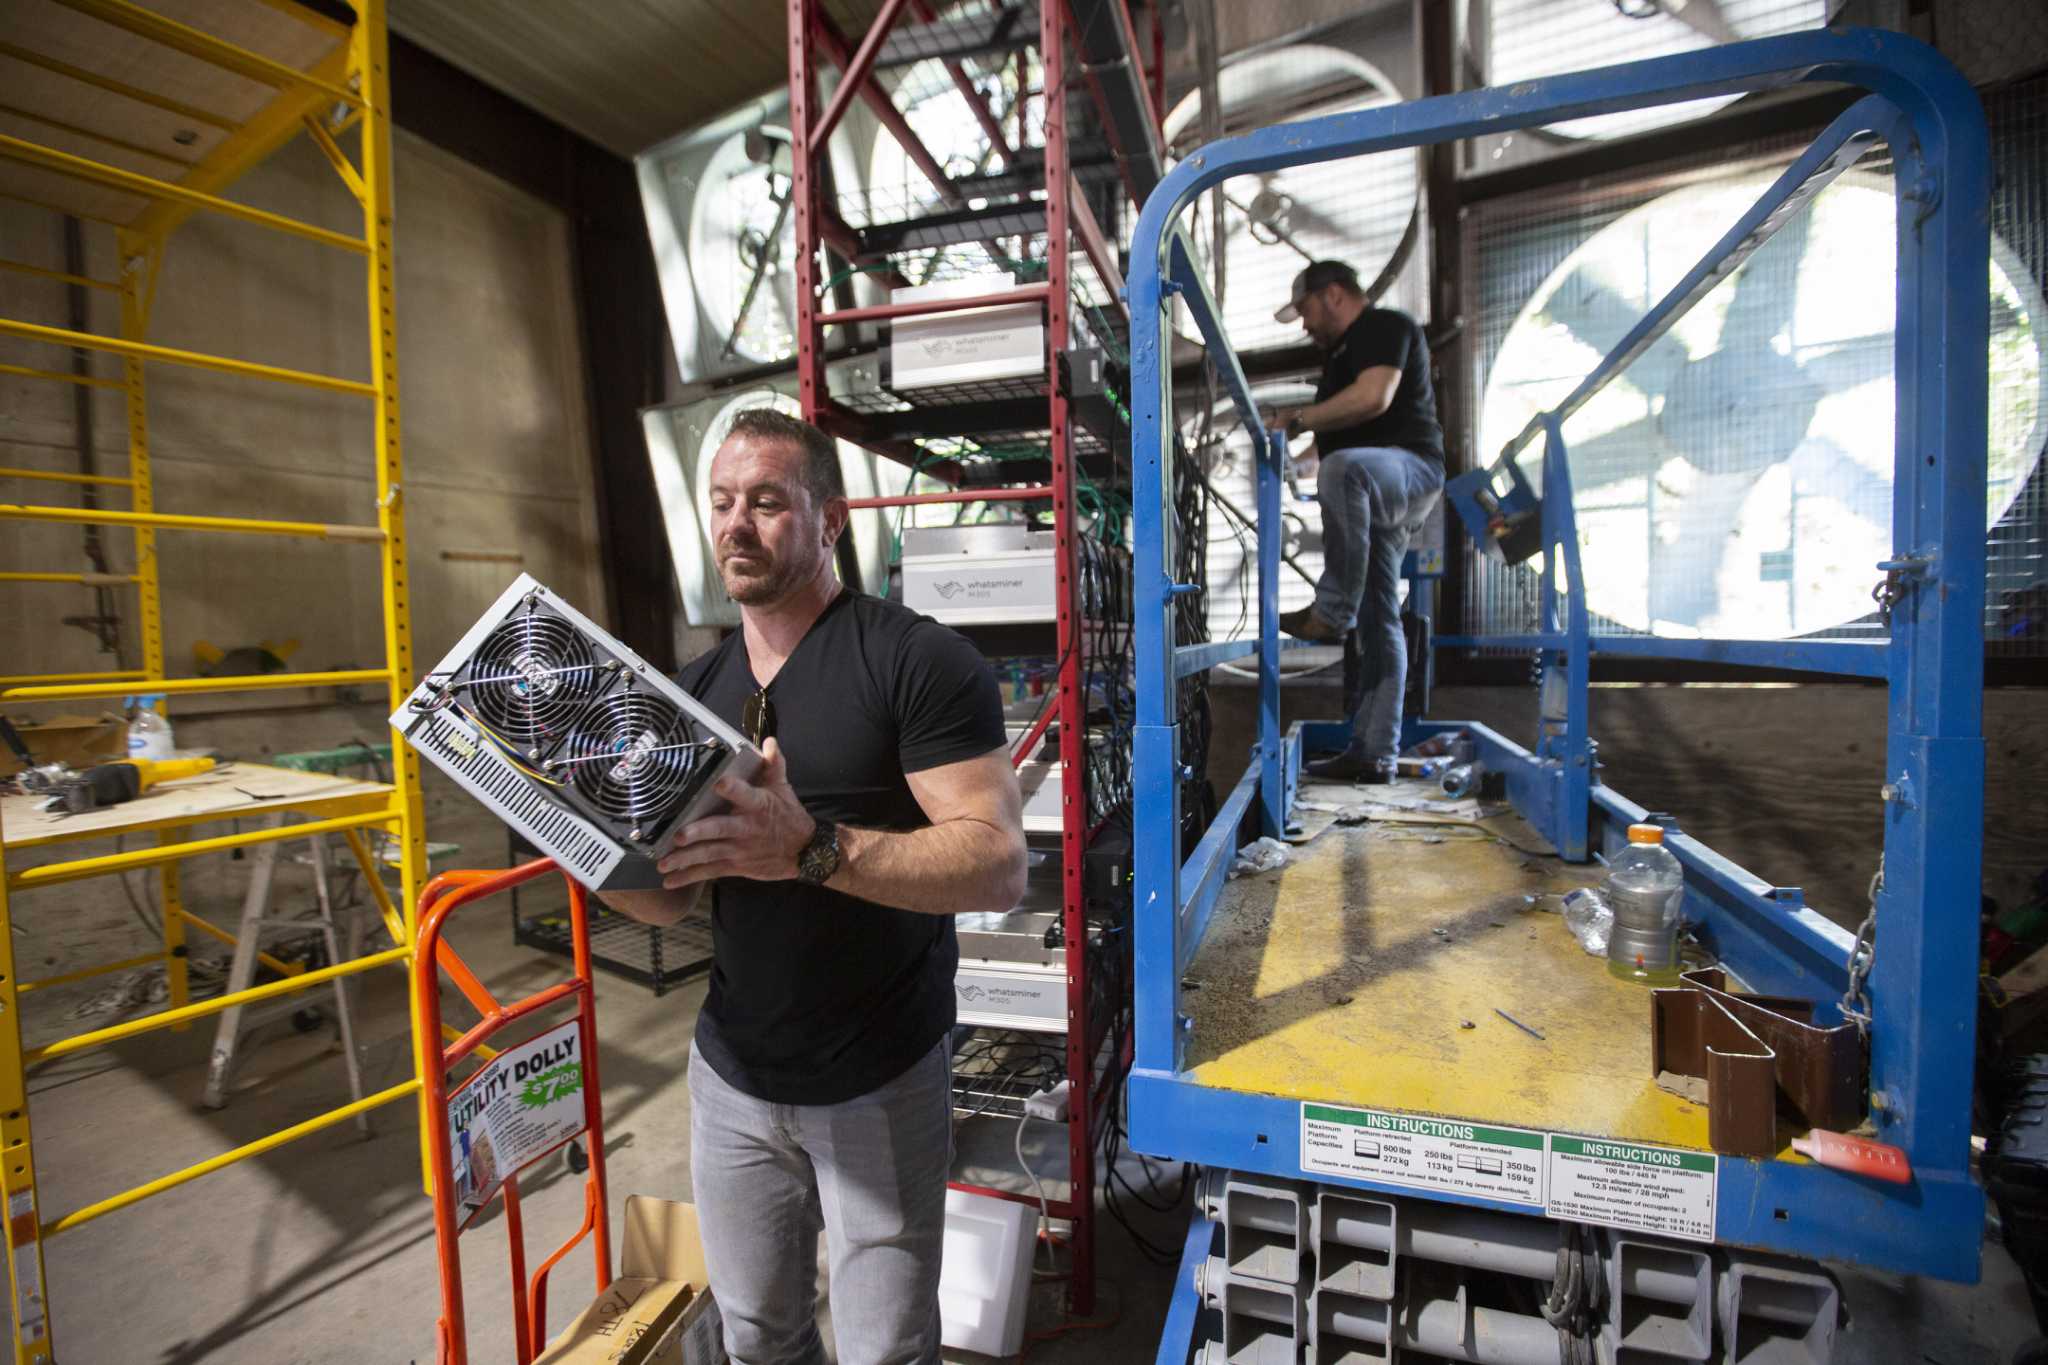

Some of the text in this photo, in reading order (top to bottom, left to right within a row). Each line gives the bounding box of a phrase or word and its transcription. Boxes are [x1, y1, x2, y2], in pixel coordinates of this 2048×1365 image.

[968, 578, 1023, 588] whatsminer
[988, 988, 1041, 998] whatsminer
[454, 1067, 510, 1132] UTILITY
[514, 1036, 575, 1082] DOLLY
[1308, 1123, 1341, 1132] Maximum
[1367, 1113, 1474, 1139] INSTRUCTIONS
[1308, 1131, 1337, 1140] Platform
[1354, 1128, 1411, 1142] Platform retracted
[1308, 1139, 1343, 1149] Capacities
[1450, 1141, 1512, 1155] Platform extended
[1399, 1146, 1411, 1155] lbs
[1424, 1150, 1453, 1161] 250 lbs
[1583, 1142, 1681, 1166] INSTRUCTIONS
[1384, 1155, 1409, 1166] 272 kg
[1561, 1154, 1592, 1163] Maximum
[1594, 1158, 1625, 1168] allowable
[1643, 1165, 1660, 1173] force
[1427, 1161, 1453, 1173] 113 kg
[1506, 1162, 1536, 1172] 350 lbs
[1523, 1174, 1534, 1185] kg
[1577, 1173, 1608, 1182] Maximum
[1611, 1179, 1641, 1188] allowable
[1574, 1192, 1605, 1200] Maximum
[1607, 1197, 1632, 1205] number
[1580, 1204, 1611, 1213] Maximum
[1580, 1211, 1611, 1220] Maximum
[1613, 1216, 1641, 1225] Platform
